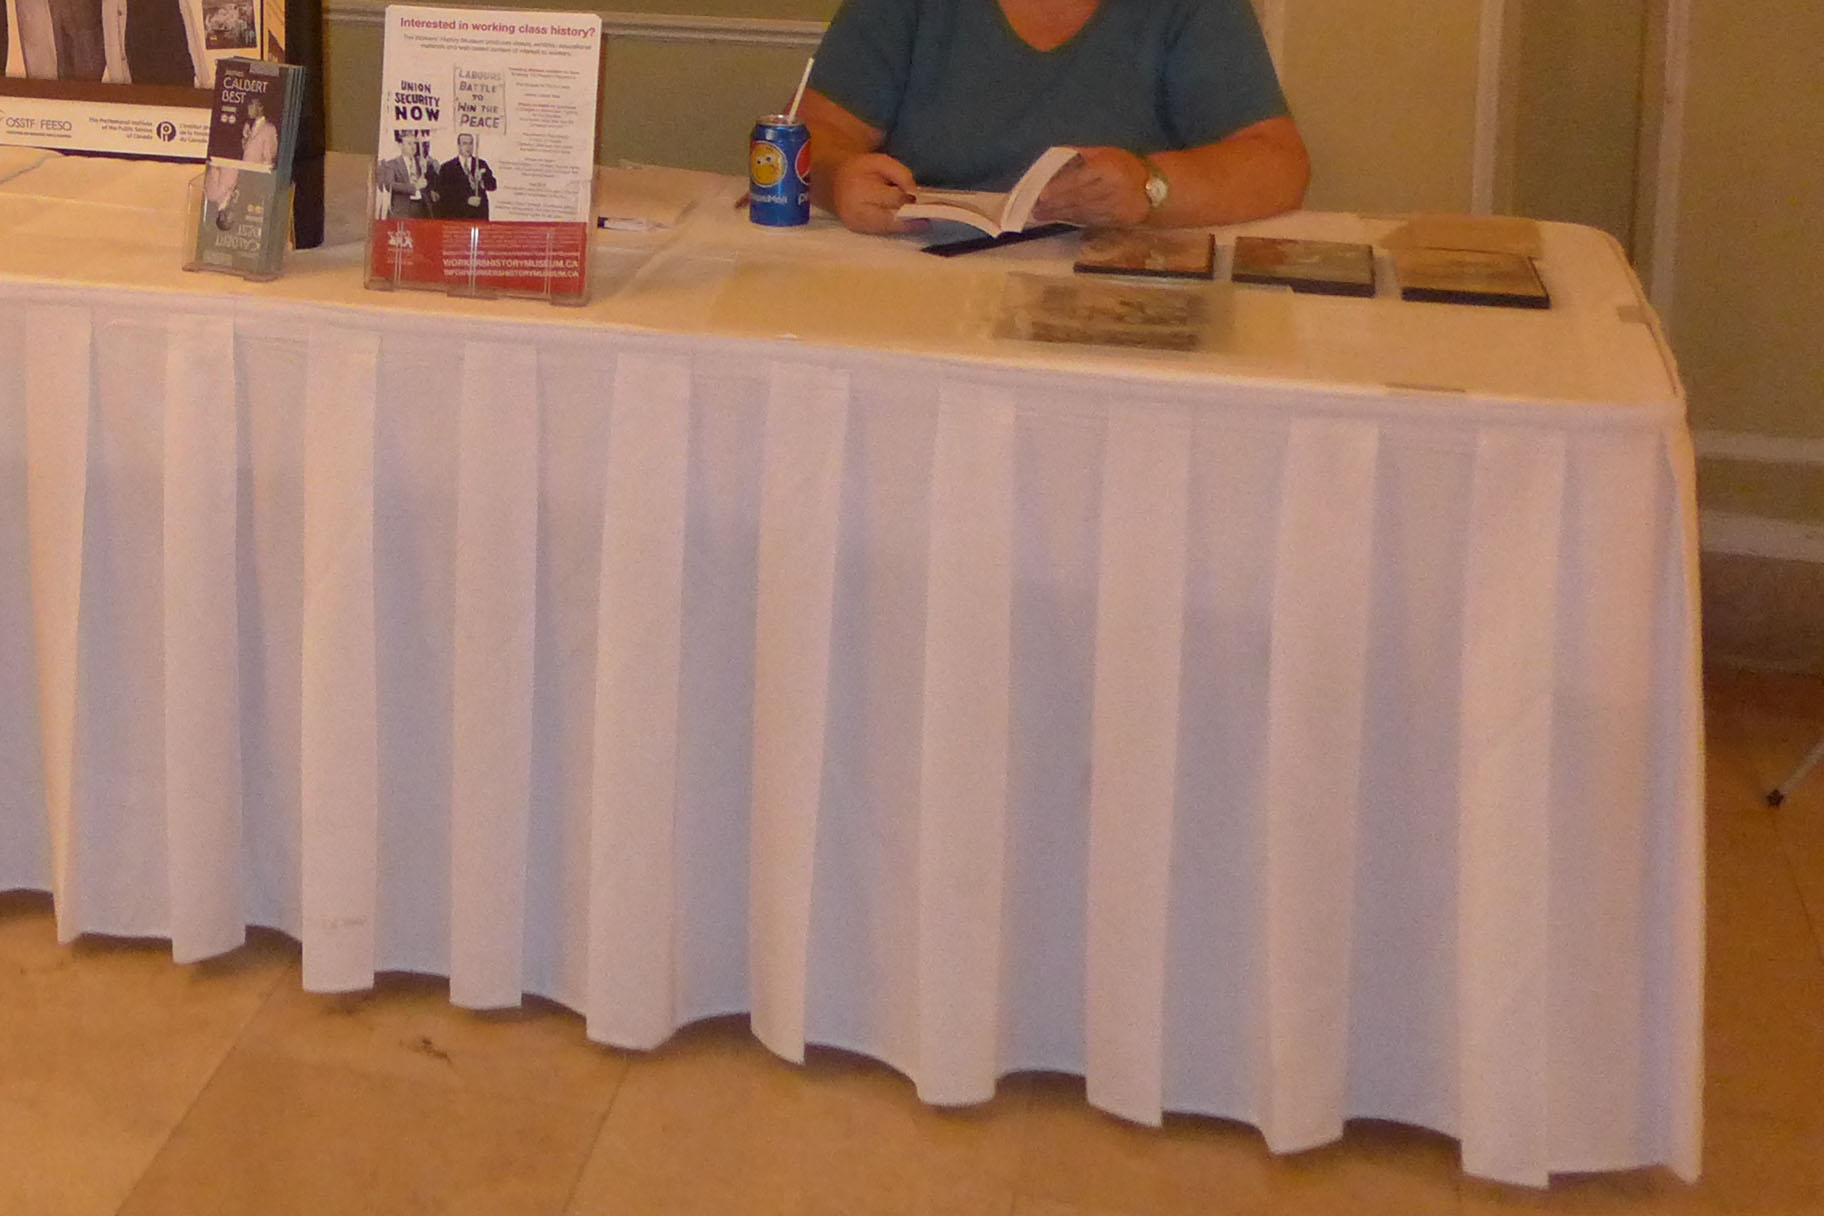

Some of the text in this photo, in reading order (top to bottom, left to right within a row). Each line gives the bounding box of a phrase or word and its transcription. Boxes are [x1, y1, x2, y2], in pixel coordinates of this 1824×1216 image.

[401, 17, 595, 39] Interested in working class history?
[401, 80, 432, 93] UNION
[221, 90, 247, 104] BEST
[394, 92, 441, 108] SECURITY
[394, 105, 441, 123] NOW
[6, 117, 37, 130] OSSTF
